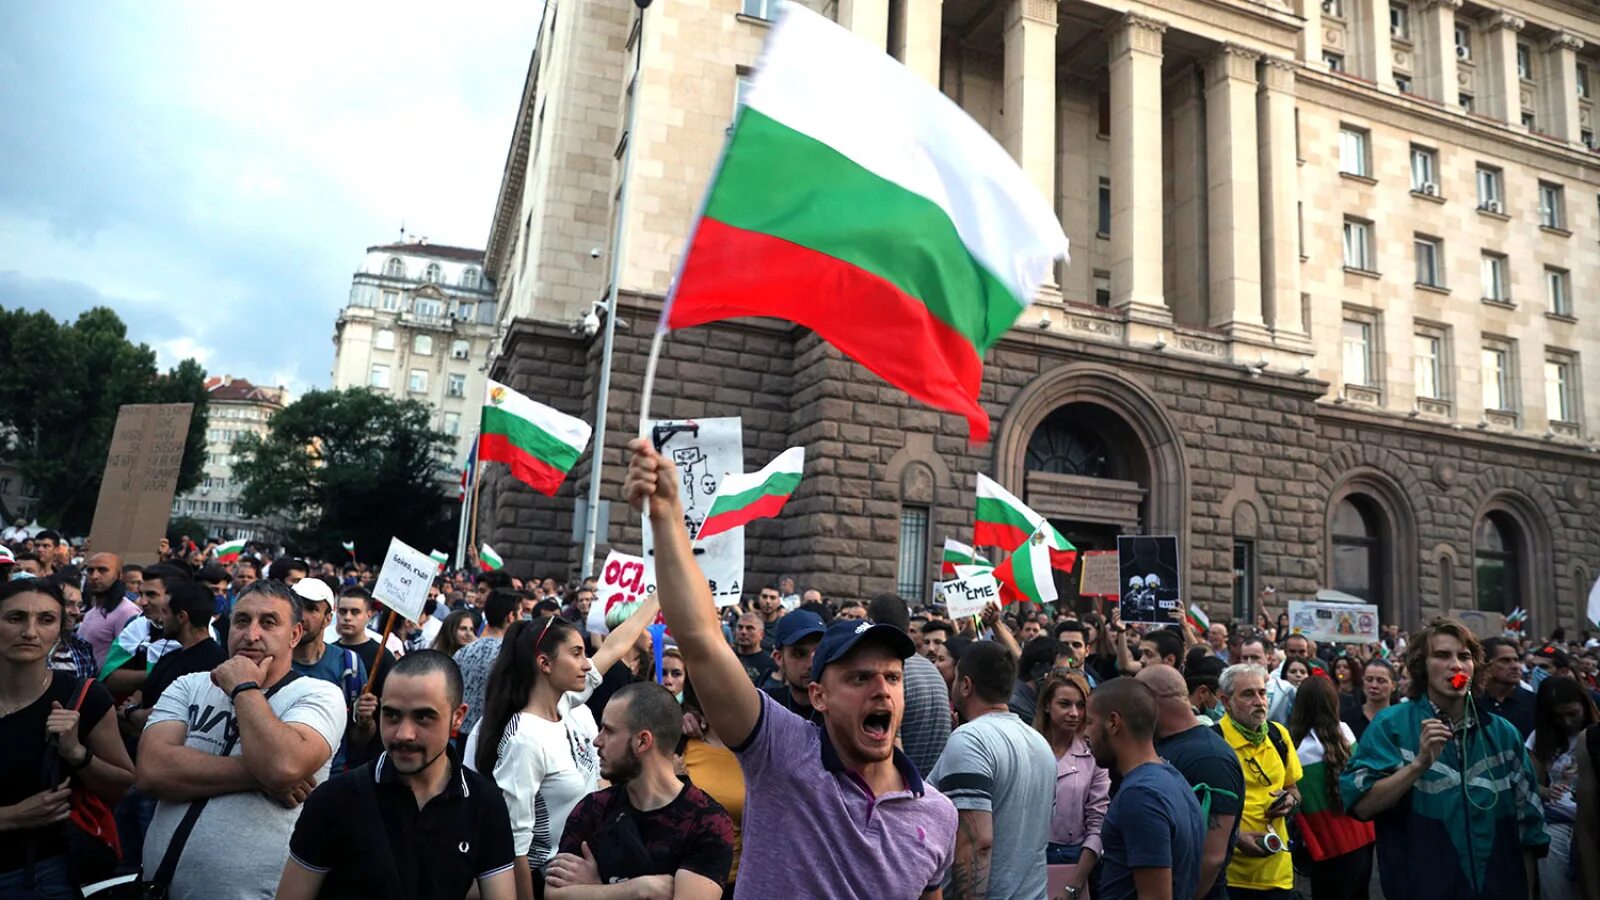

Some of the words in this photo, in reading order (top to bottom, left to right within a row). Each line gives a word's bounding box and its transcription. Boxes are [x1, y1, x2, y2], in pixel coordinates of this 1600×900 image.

[393, 554, 412, 572] Бойко,
[400, 577, 411, 587] си?
[605, 560, 644, 595] ОСТ
[944, 581, 969, 593] ТУК
[966, 585, 994, 600] СМЕ
